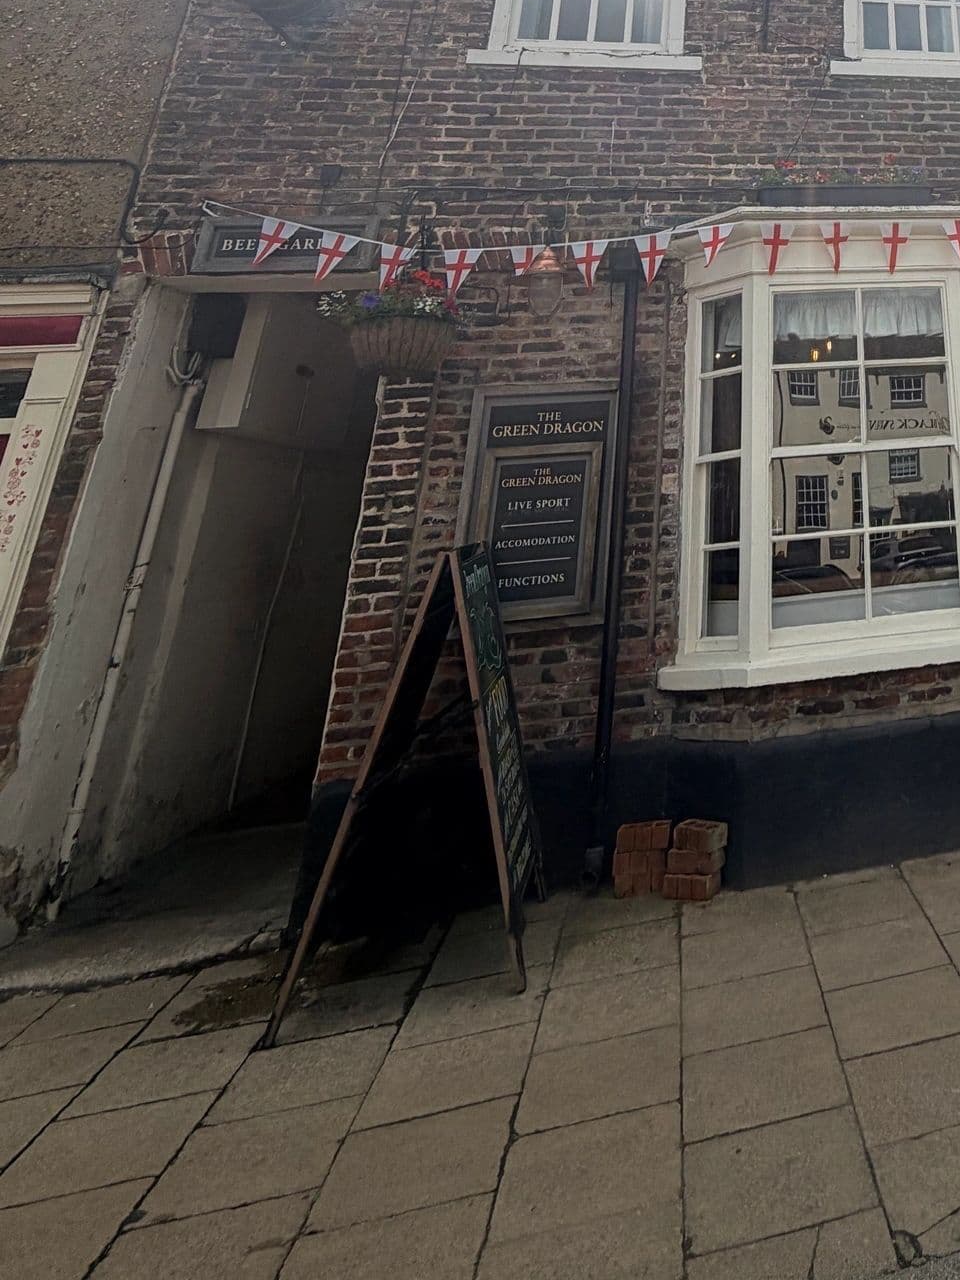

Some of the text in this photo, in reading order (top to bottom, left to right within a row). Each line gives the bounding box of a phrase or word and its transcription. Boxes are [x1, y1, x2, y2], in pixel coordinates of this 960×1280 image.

[221, 238, 258, 251] BEE
[537, 412, 562, 421] THE
[492, 420, 604, 438] GREEN DRAGON
[534, 467, 551, 476] THE
[501, 474, 582, 488] GREEN DRAGON
[508, 497, 571, 511] LIVE SPORT
[494, 534, 576, 549] ACCOMODATION
[498, 572, 565, 588] FUNCTIONS
